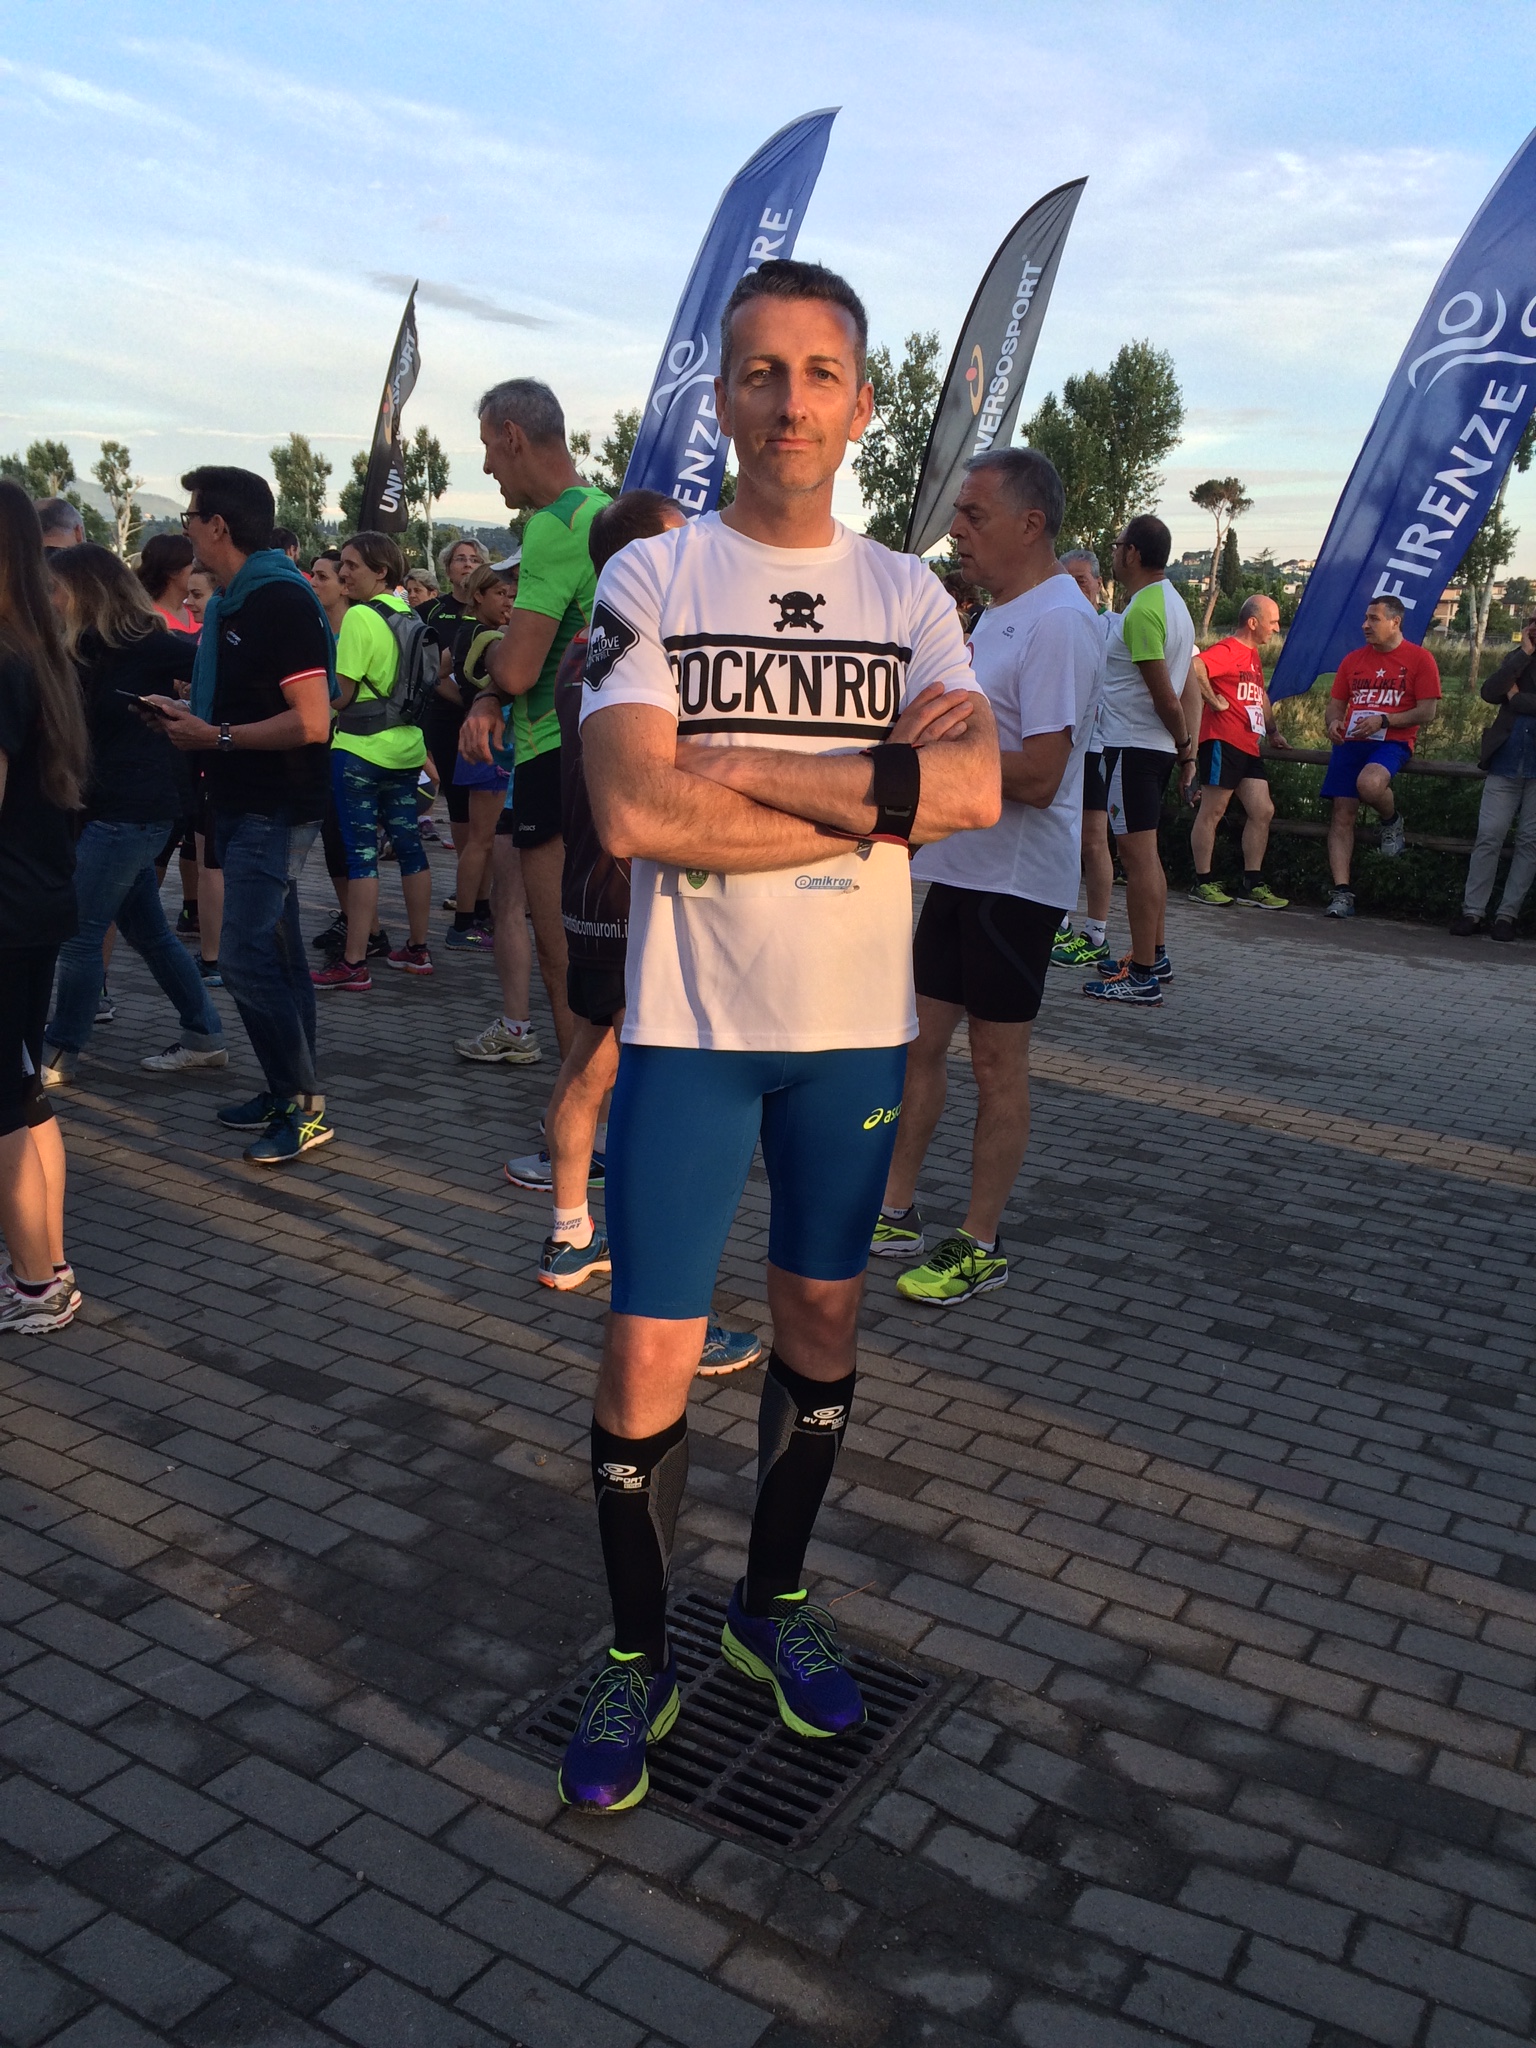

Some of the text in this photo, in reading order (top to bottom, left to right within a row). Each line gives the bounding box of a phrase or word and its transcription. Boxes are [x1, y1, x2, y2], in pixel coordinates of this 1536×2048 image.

[672, 394, 721, 523] ENZE
[1372, 380, 1528, 610] FIRENZE
[598, 635, 620, 652] LOVE
[1351, 688, 1406, 707] DEEJAY
[554, 1217, 582, 1226] OLOTTO
[555, 1223, 581, 1231] PORT
[609, 1474, 646, 1484] SPORT
